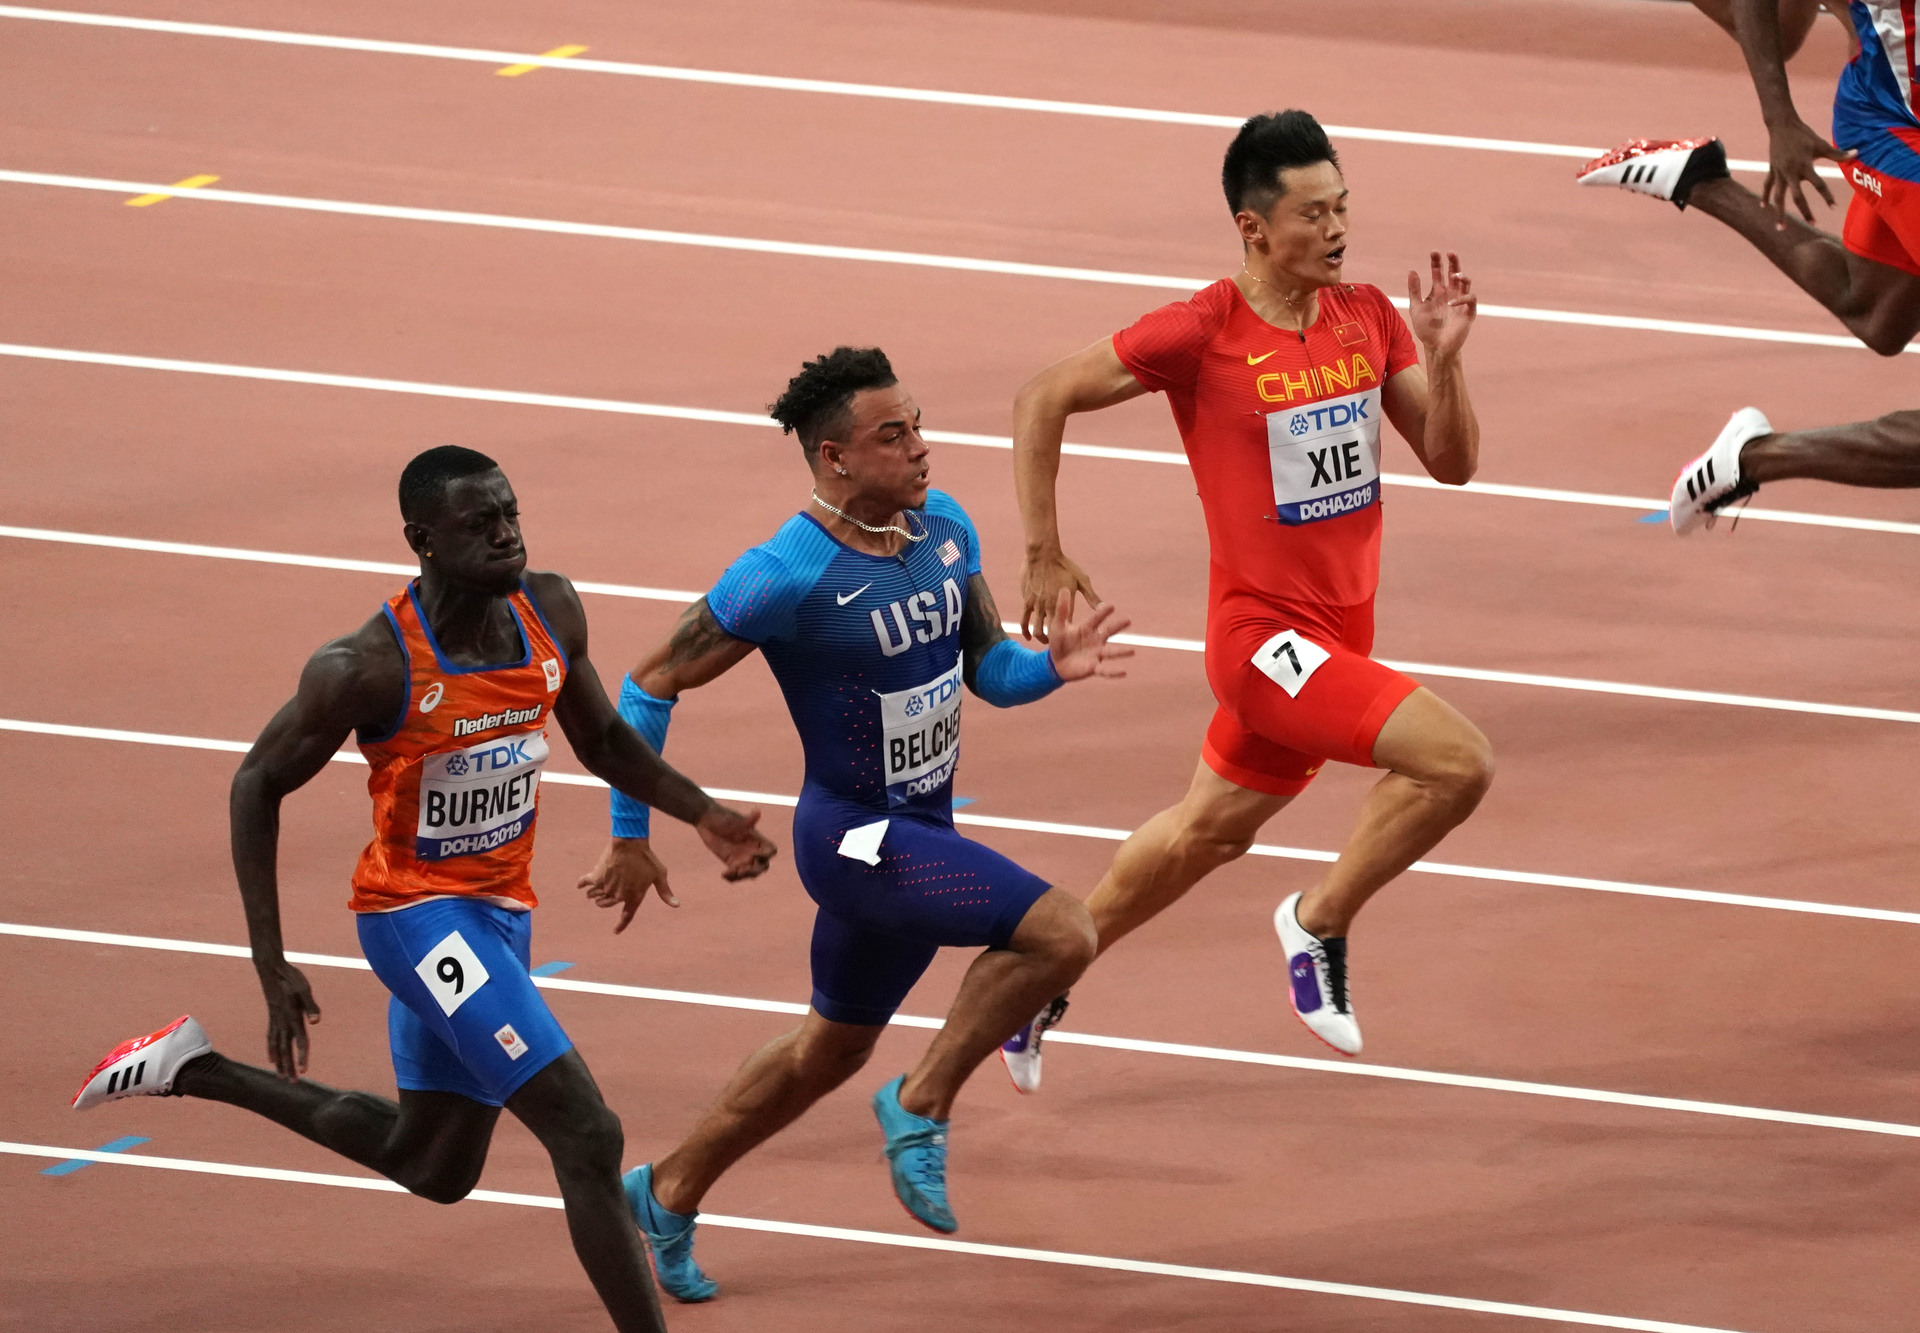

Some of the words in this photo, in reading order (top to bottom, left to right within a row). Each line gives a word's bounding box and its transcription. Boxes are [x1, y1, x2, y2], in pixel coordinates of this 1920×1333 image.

[1256, 353, 1376, 403] CHINA
[1307, 398, 1369, 432] TDK
[1307, 440, 1362, 489] XIE
[1300, 485, 1372, 522] DOHA2019
[870, 577, 963, 658] USA
[1272, 641, 1303, 677] 7
[453, 703, 542, 737] Nederland
[469, 739, 533, 773] TDK
[426, 768, 535, 828] BURNET
[440, 820, 522, 857] DOHA2019
[436, 956, 464, 996] 9
